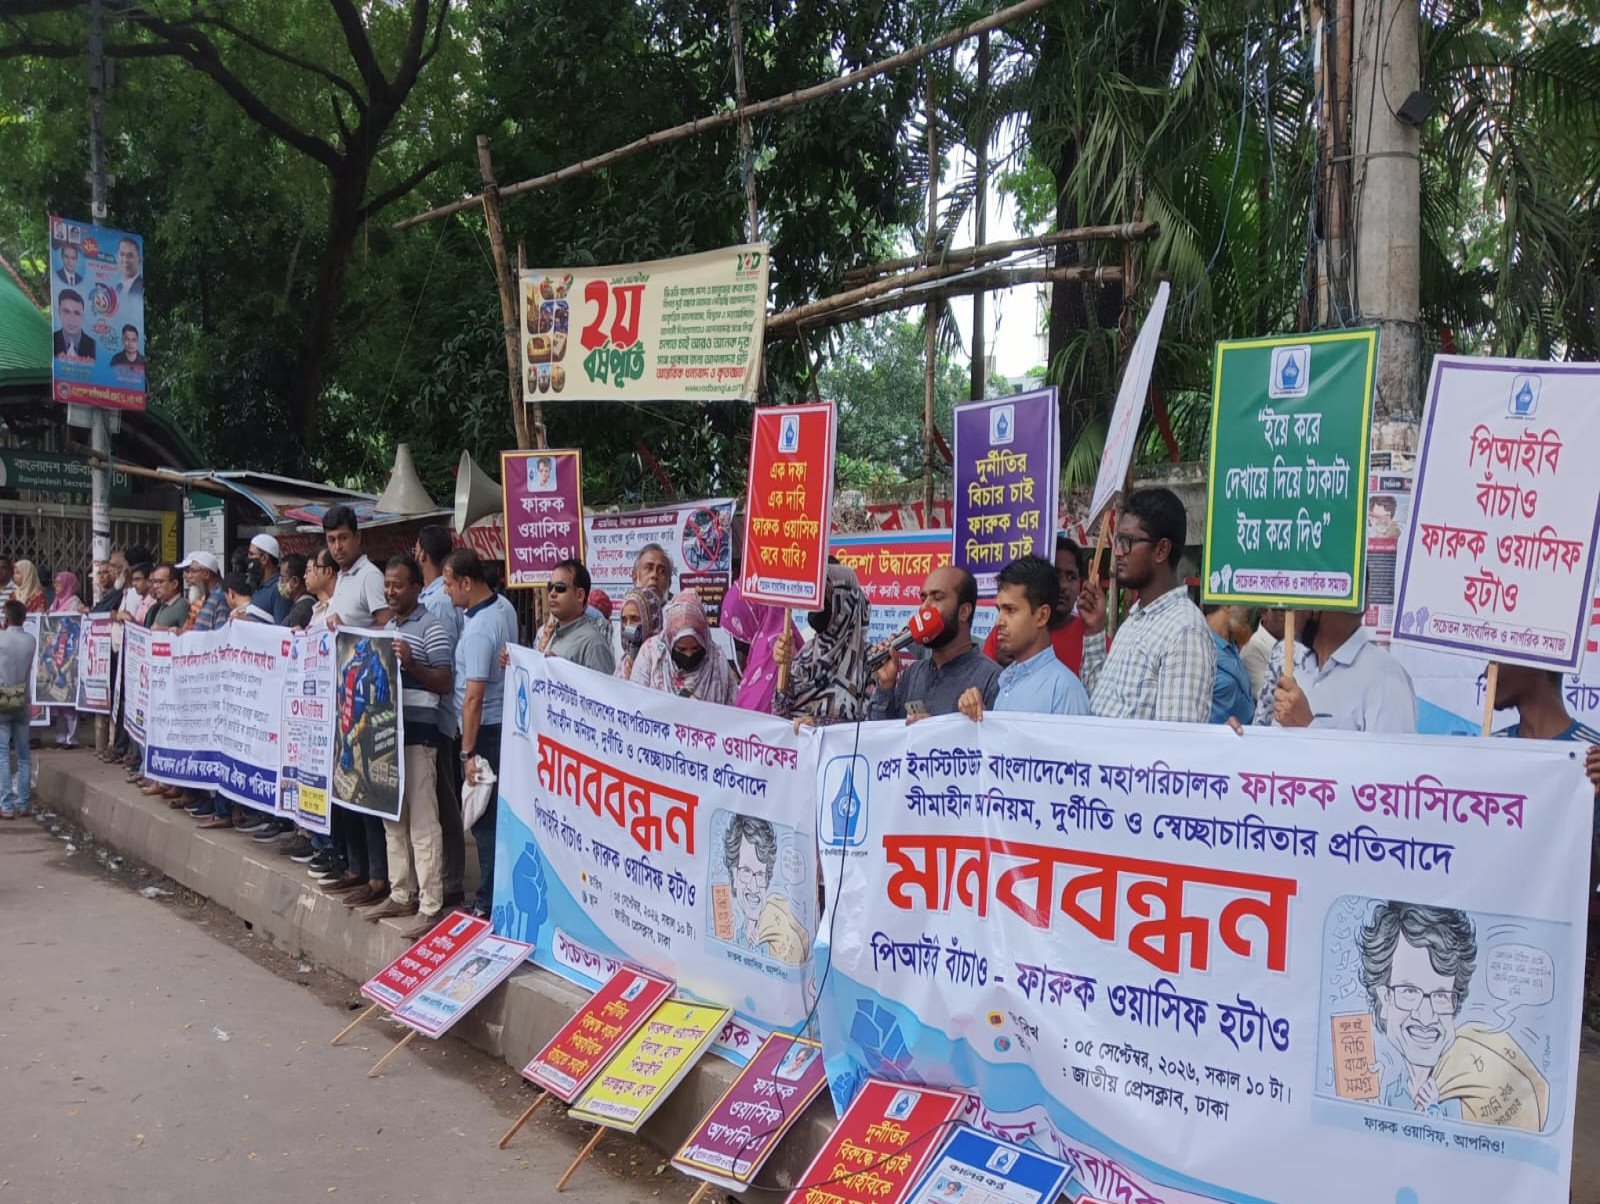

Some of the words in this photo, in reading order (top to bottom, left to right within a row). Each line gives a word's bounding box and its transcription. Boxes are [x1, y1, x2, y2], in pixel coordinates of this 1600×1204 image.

[1294, 412, 1322, 446] করে
[976, 449, 1027, 483] দুর্নীতির
[1469, 423, 1563, 476] পিআইবি
[14, 458, 61, 474] বাংলাদেশ
[63, 460, 92, 476] সচিবা
[18, 475, 62, 487] Bangladesh
[770, 462, 785, 480] এক
[788, 461, 808, 483] দফা
[1225, 461, 1269, 500] দেখায়ে
[1273, 455, 1303, 500] দিয়ে
[1306, 454, 1351, 500] টাকাটা
[520, 496, 565, 514] ফারুক
[768, 492, 783, 508] এক
[786, 484, 806, 513] দাবি
[968, 482, 1004, 509] বিচার
[1009, 478, 1035, 503] চাই
[1475, 471, 1538, 520] বাঁচাও
[518, 517, 571, 538] ওয়াসিফ
[752, 516, 780, 538] ফারুক
[783, 514, 819, 541] ওয়াসিফ
[967, 513, 1011, 537] ফারুক
[1017, 509, 1040, 531] এর
[1236, 509, 1262, 555] ইয়ে
[1265, 518, 1293, 551] করে
[514, 542, 575, 564] আপনিও!
[760, 546, 779, 567] কবে
[782, 542, 807, 570] যাবি?
[879, 548, 933, 576] উদ্ধারের
[966, 540, 1002, 565] বিদায়
[1009, 534, 1034, 559] চাই
[1420, 523, 1488, 562] ফারুক
[1496, 525, 1584, 573] ওয়াসিফ
[879, 581, 901, 599] করছি
[1235, 573, 1259, 590] সচেতন
[1260, 571, 1291, 592] সাংবাদিক
[1300, 572, 1326, 592] নাগরিক
[1328, 576, 1348, 594] সমাজ
[1464, 566, 1518, 615] হটাও
[1433, 618, 1459, 635] সচেতন
[1462, 621, 1498, 641] সাংবাদিক
[1501, 631, 1507, 643] ও
[1510, 627, 1539, 648] নাগরিক
[1542, 635, 1567, 653] সমাজ
[546, 707, 571, 736] সীমাহীন
[627, 746, 633, 760] ও
[637, 746, 708, 782] স্বেচ্ছাচারিতার
[713, 763, 768, 797] প্রতিবাদে
[617, 708, 670, 738] মহাপরিচালক
[674, 722, 717, 752] ফারুক
[722, 733, 798, 771] ওয়াসিফের
[537, 733, 699, 855] মানববন্ধন
[876, 760, 901, 782] প্রেস
[988, 753, 1093, 789] বাংলাদেশের
[1098, 760, 1230, 801] মহাপরিচালক
[1237, 771, 1339, 810] ফারুক
[1351, 773, 1529, 830] ওয়াসিফের
[905, 785, 972, 820] সীমাহীন
[975, 787, 1042, 830] অনিয়ম,
[1124, 812, 1143, 835] ও
[1154, 813, 1319, 859] স্বেচ্ছাচারিতার
[1328, 824, 1456, 874] প্রতিবাদে
[560, 815, 583, 853] বাঁচাও
[591, 839, 620, 869] ফারুক
[624, 855, 664, 894] ওয়াসিফ
[667, 863, 697, 907] হটাও
[882, 833, 1298, 975] মানববন্ধন
[559, 930, 601, 975] সচেতন
[945, 935, 988, 990] বাঁচাও
[1016, 961, 1097, 1013] ফারুক
[1108, 977, 1209, 1037] ওয়াসিফ
[1217, 993, 1291, 1053] হটাও
[1075, 1040, 1093, 1057] ০৫
[1099, 1040, 1153, 1075] সেপ্টেম্বর,
[1158, 1054, 1200, 1085] ২০২৬,
[1204, 1064, 1241, 1093] সকাল
[1245, 1077, 1265, 1097] ১০
[753, 1077, 798, 1099] ফারুক
[1071, 1063, 1119, 1094] জাতীয়
[1124, 1079, 1189, 1115] প্রেসক্লাব,
[1194, 1094, 1230, 1122] ঢাকা
[729, 1101, 784, 1125] ওয়াসিফ
[865, 1120, 910, 1146] দুর্নীতির
[1363, 1116, 1399, 1135] ফারুক
[1402, 1122, 1449, 1148] ওয়াসিফ,
[1453, 1134, 1506, 1153] আপনিও!
[834, 1138, 878, 1166] বিরুদ্ধে
[827, 1163, 894, 1196] পিআইবিকে
[949, 1164, 985, 1183] কালের
